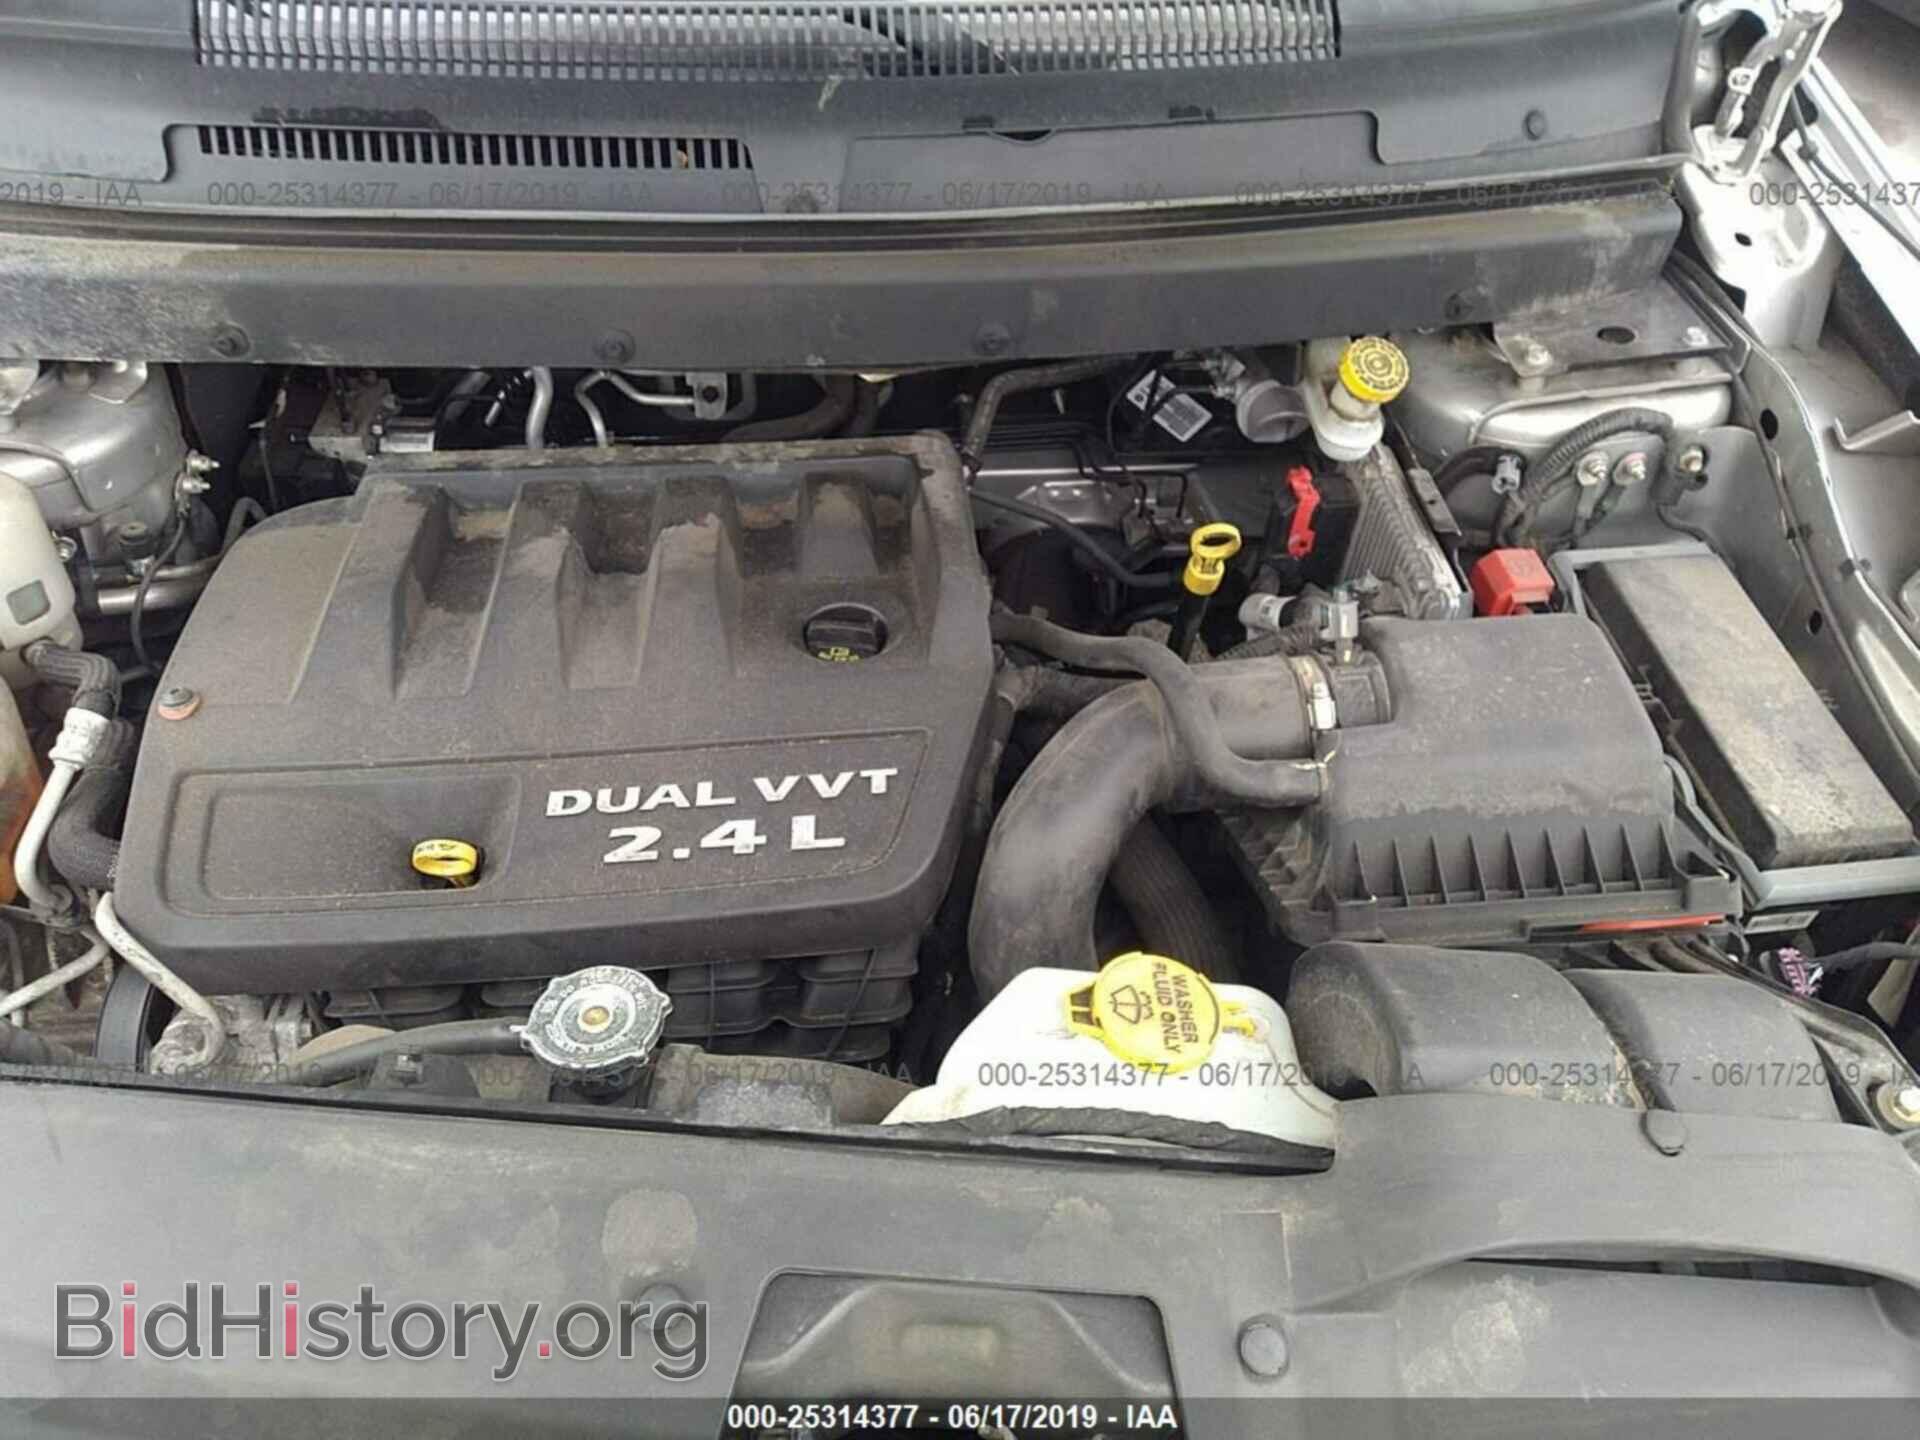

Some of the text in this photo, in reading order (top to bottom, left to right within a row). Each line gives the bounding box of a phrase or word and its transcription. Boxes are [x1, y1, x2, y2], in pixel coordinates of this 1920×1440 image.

[545, 768, 899, 817] DUAL VVT
[1152, 961, 1183, 1054] FLUID ONLY
[1171, 973, 1199, 1045] WASHER
